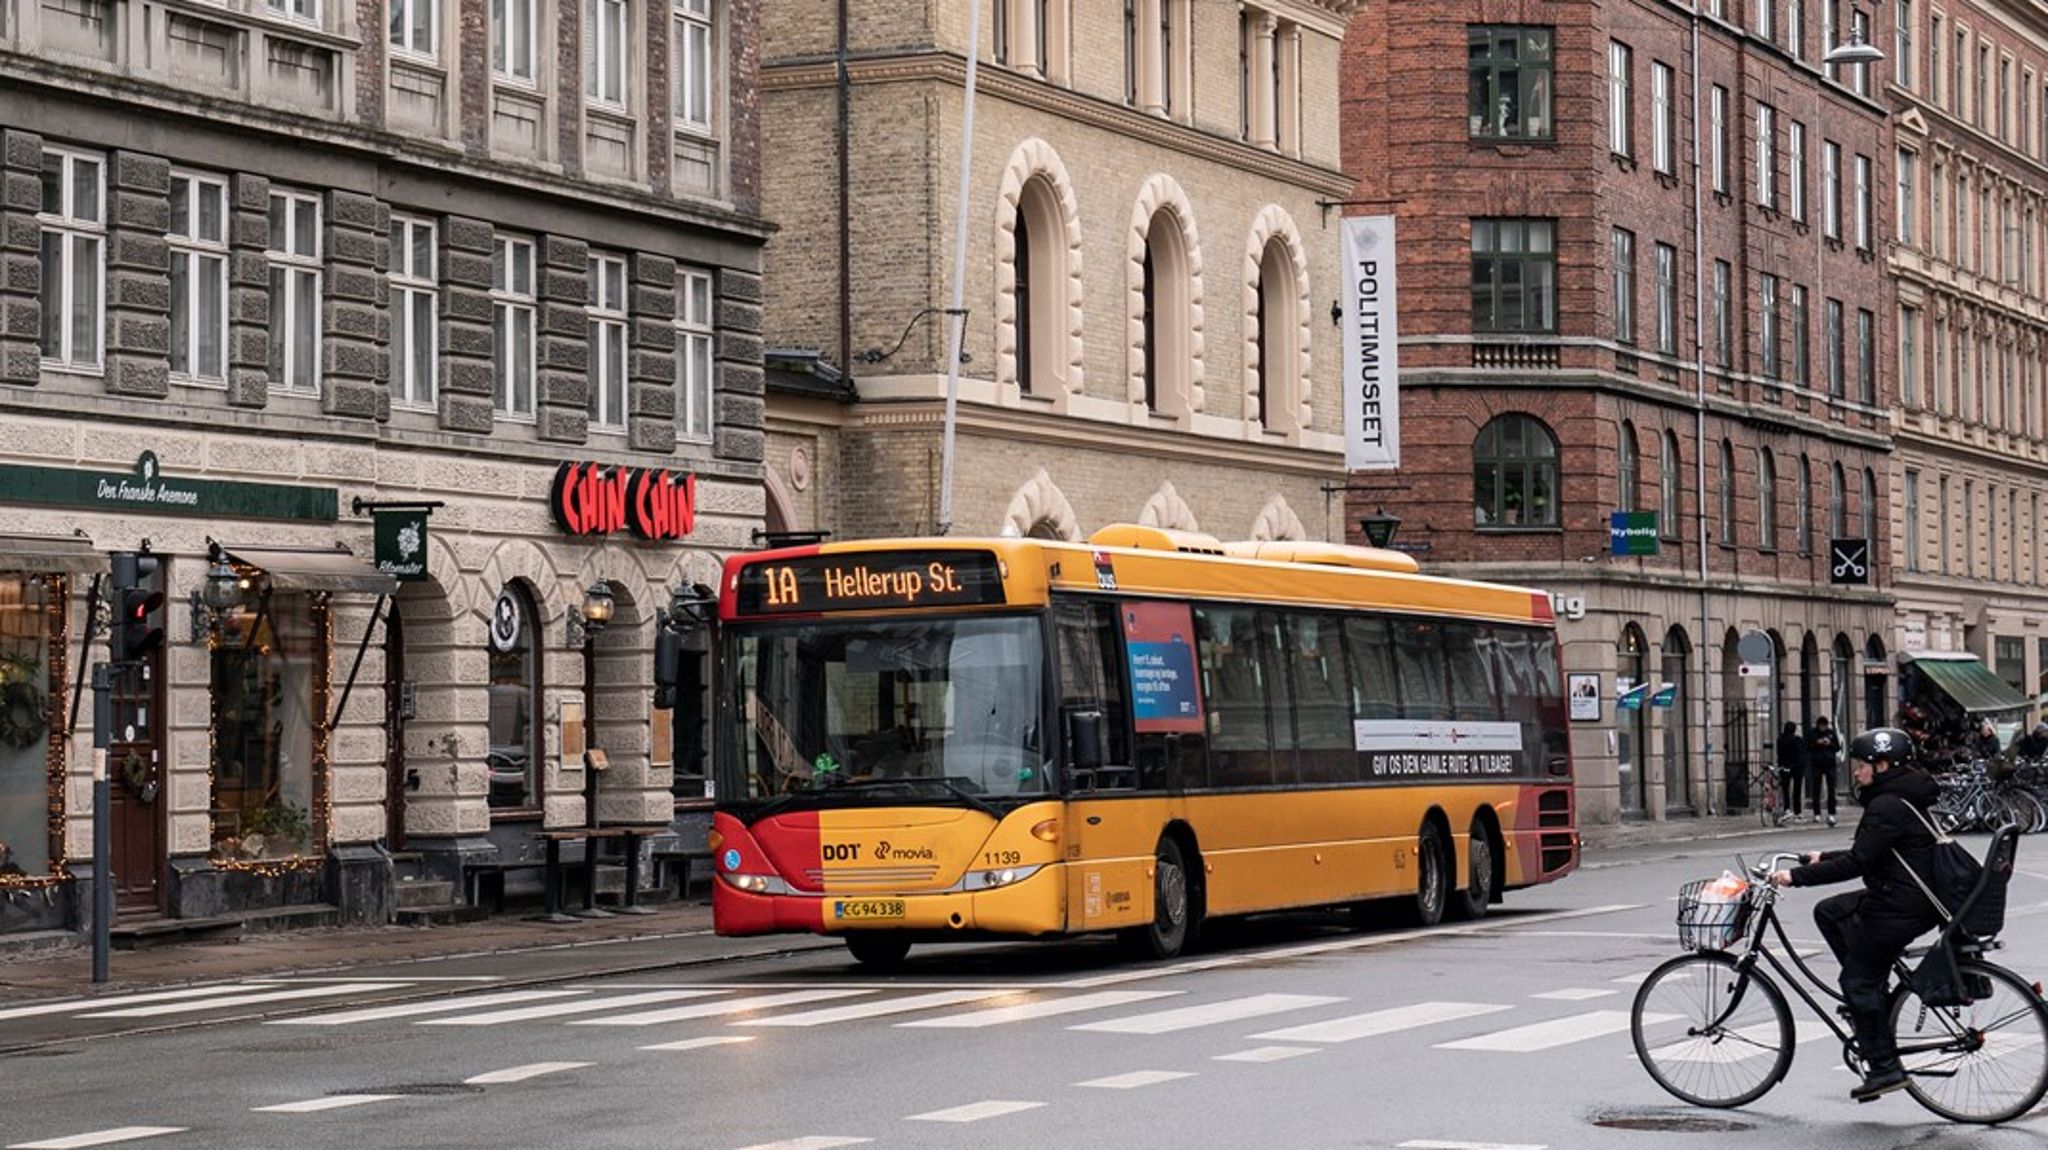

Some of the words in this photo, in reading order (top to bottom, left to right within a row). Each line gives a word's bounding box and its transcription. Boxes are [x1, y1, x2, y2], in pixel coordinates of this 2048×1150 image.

[1358, 260, 1382, 448] POLITIMUSEET
[97, 478, 117, 499] Den
[118, 480, 156, 502] Franske
[157, 483, 198, 506] Anemone
[1611, 527, 1657, 538] Nybolig
[764, 566, 799, 604] 1A
[824, 565, 922, 601] Hellerup
[928, 562, 963, 592] St.
[1372, 755, 1388, 775] GIV
[1389, 755, 1401, 774] OS
[1402, 755, 1419, 774] DEN
[1420, 755, 1448, 774] GAMLE
[1449, 755, 1469, 773] RUTE
[822, 843, 860, 861] DOT
[892, 847, 934, 860] movia
[984, 851, 1021, 865] 1139
